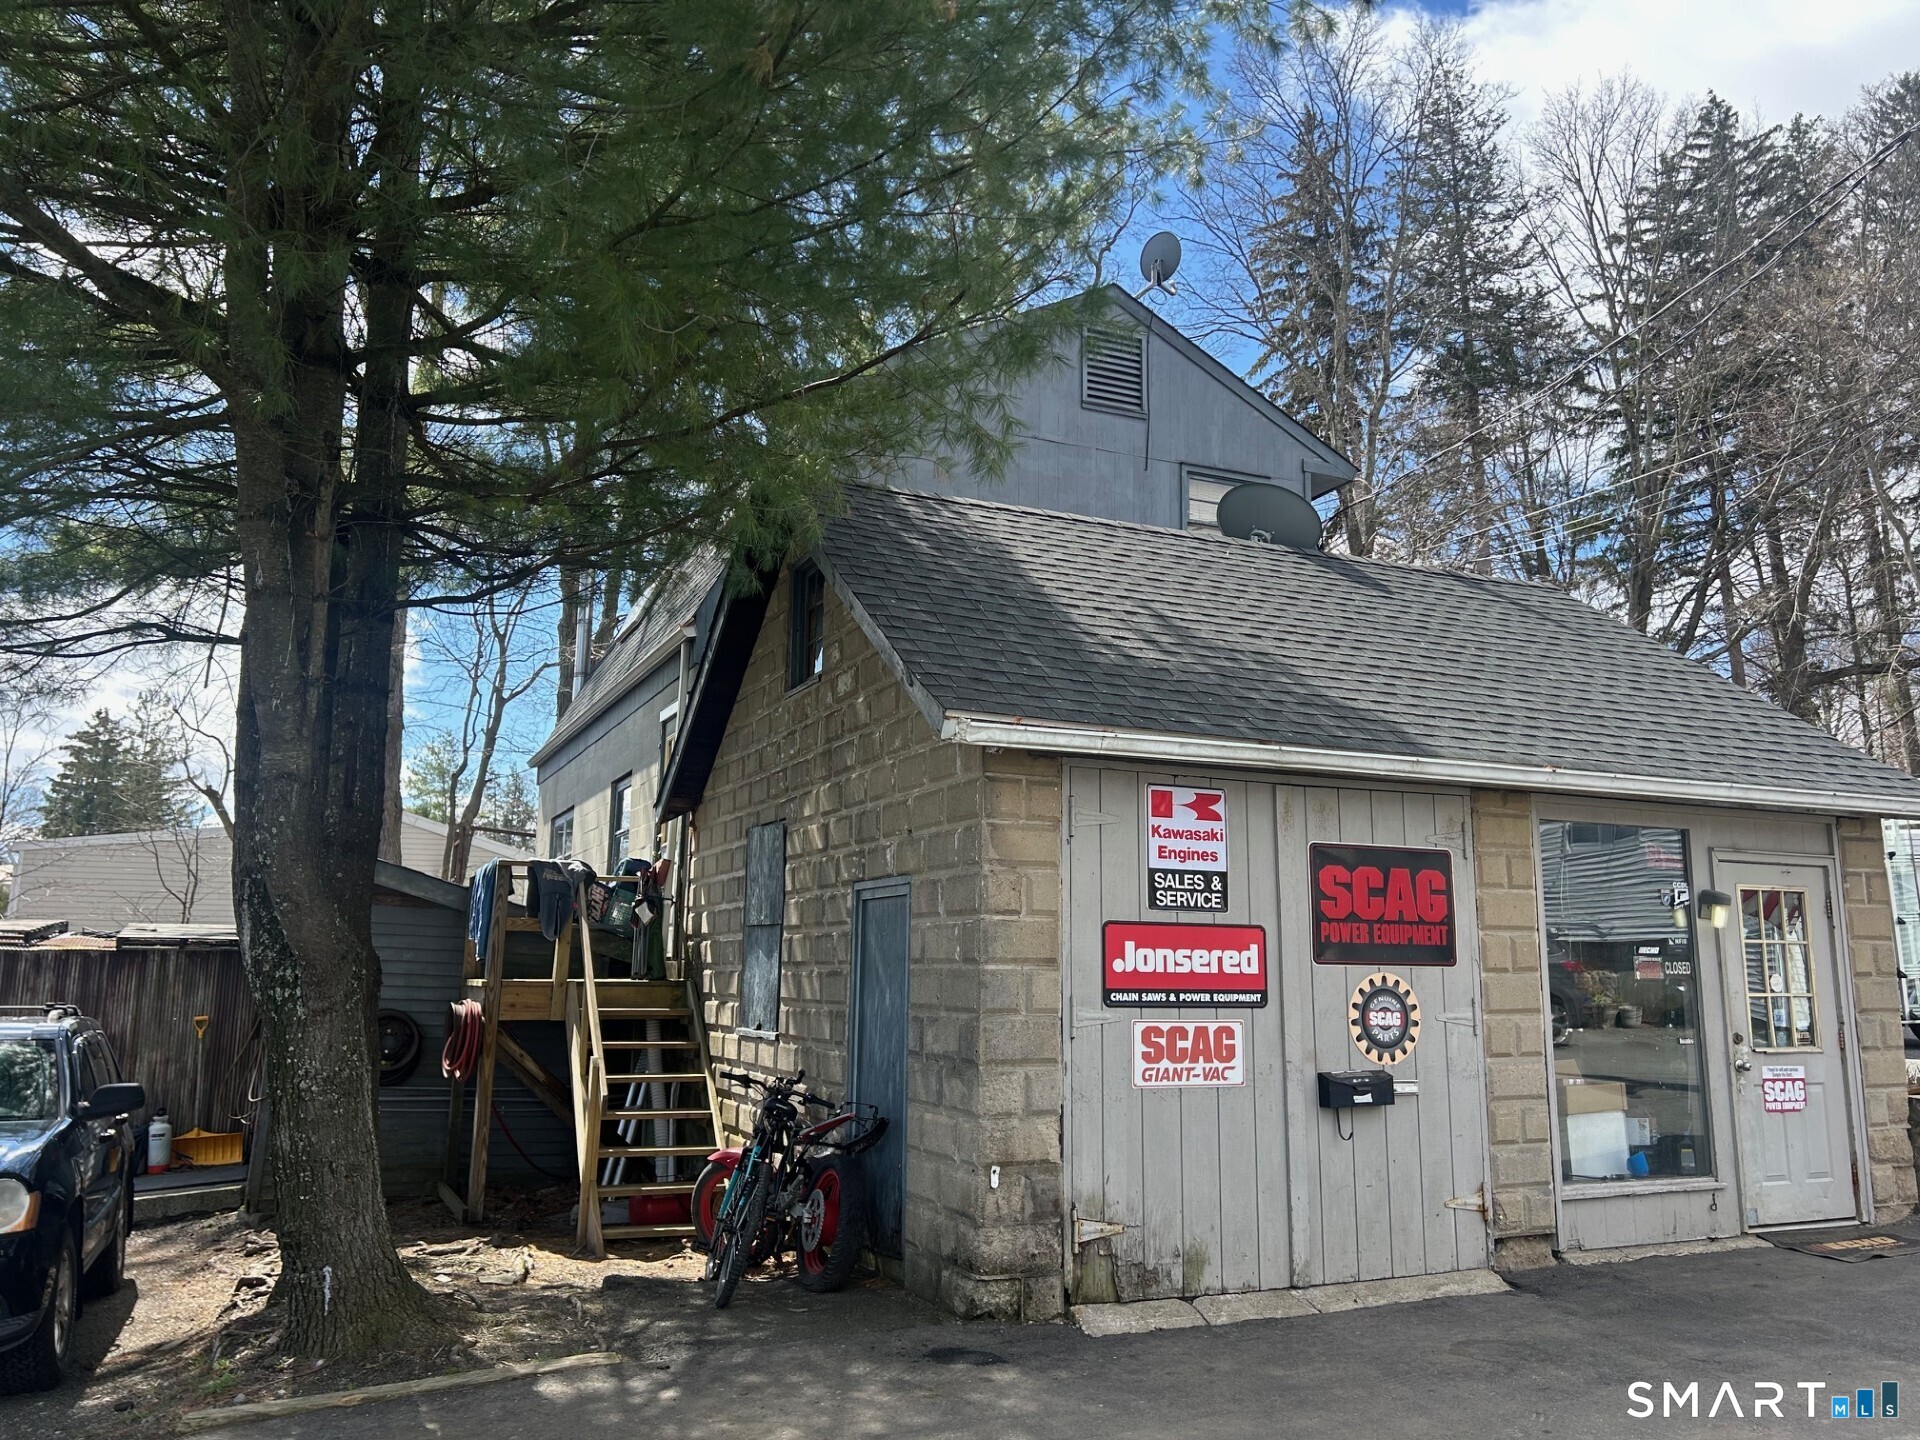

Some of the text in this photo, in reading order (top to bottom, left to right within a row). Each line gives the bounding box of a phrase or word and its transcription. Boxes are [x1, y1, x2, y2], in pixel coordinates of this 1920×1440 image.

[1151, 824, 1224, 842] Kawasaki
[1157, 845, 1219, 863] Engines
[1154, 872, 1222, 891] SALES &
[1156, 890, 1222, 908] SERVICE
[1318, 865, 1448, 923] SCAG
[1320, 922, 1448, 946] POWER EQUIPMENT
[1112, 941, 1259, 975] Jonsered
[1665, 961, 1691, 974] CLOSED
[1110, 992, 1262, 1003] CHAIN SAWS & POWER EQUIPMENT
[1369, 995, 1401, 1009] GENUINE
[1369, 1011, 1401, 1026] SCAG
[1371, 1028, 1400, 1042] PARTS
[1141, 1026, 1236, 1064] SCAG
[1141, 1066, 1236, 1083] GIANT-VAC
[1764, 1081, 1805, 1101] SCAG
